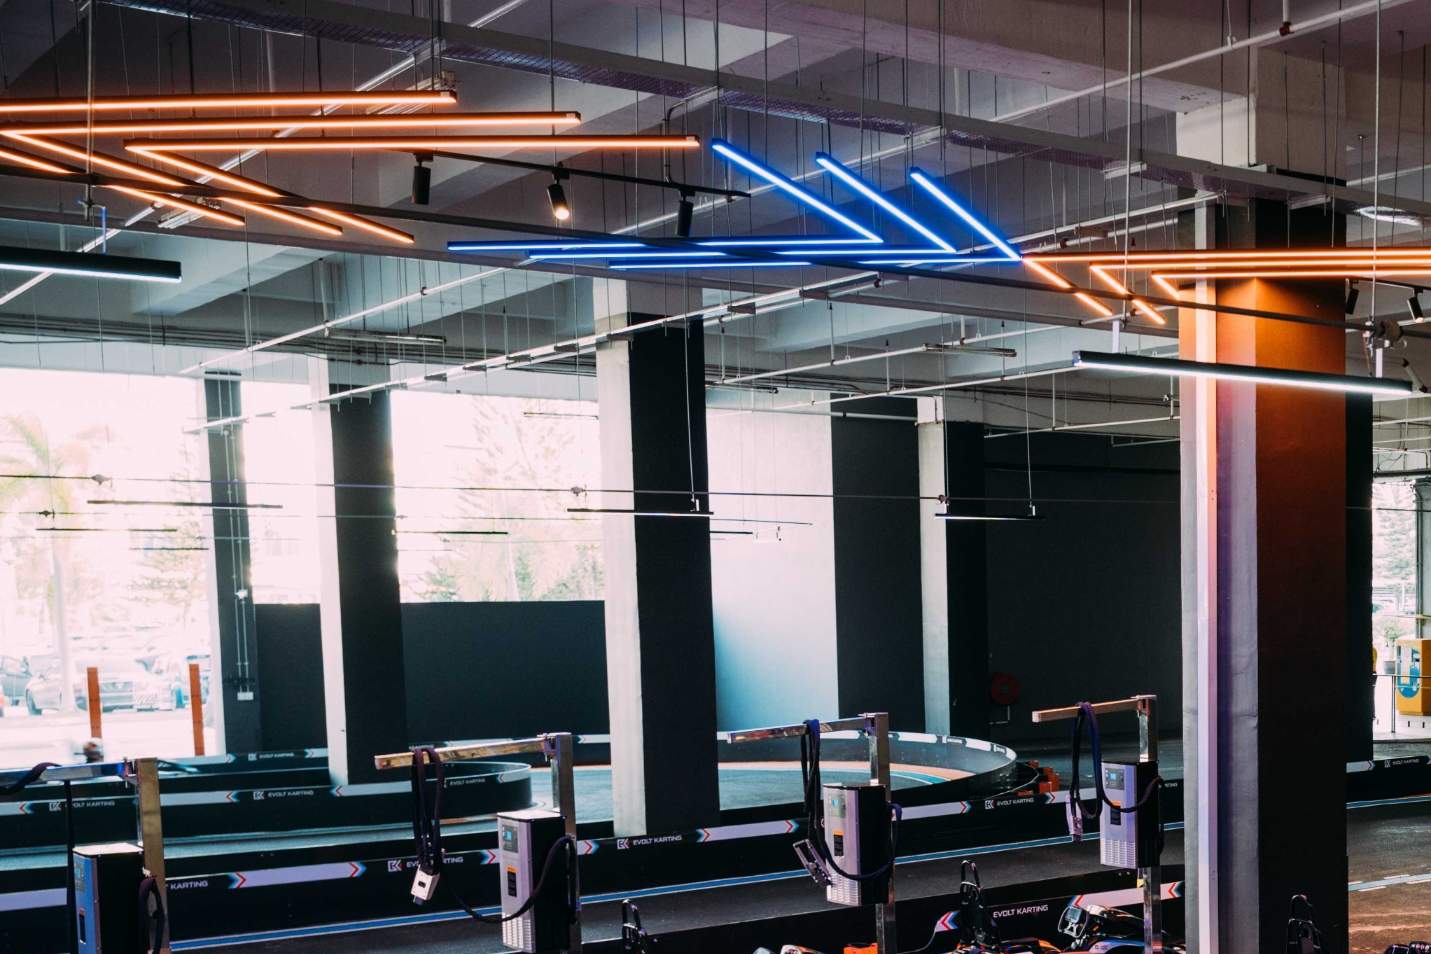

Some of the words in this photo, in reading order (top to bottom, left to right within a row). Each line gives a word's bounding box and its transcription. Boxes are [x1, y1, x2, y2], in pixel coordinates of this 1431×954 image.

[170, 880, 209, 890] KARTING
[993, 910, 1016, 919] EVOLT
[1016, 904, 1049, 915] KARTING
